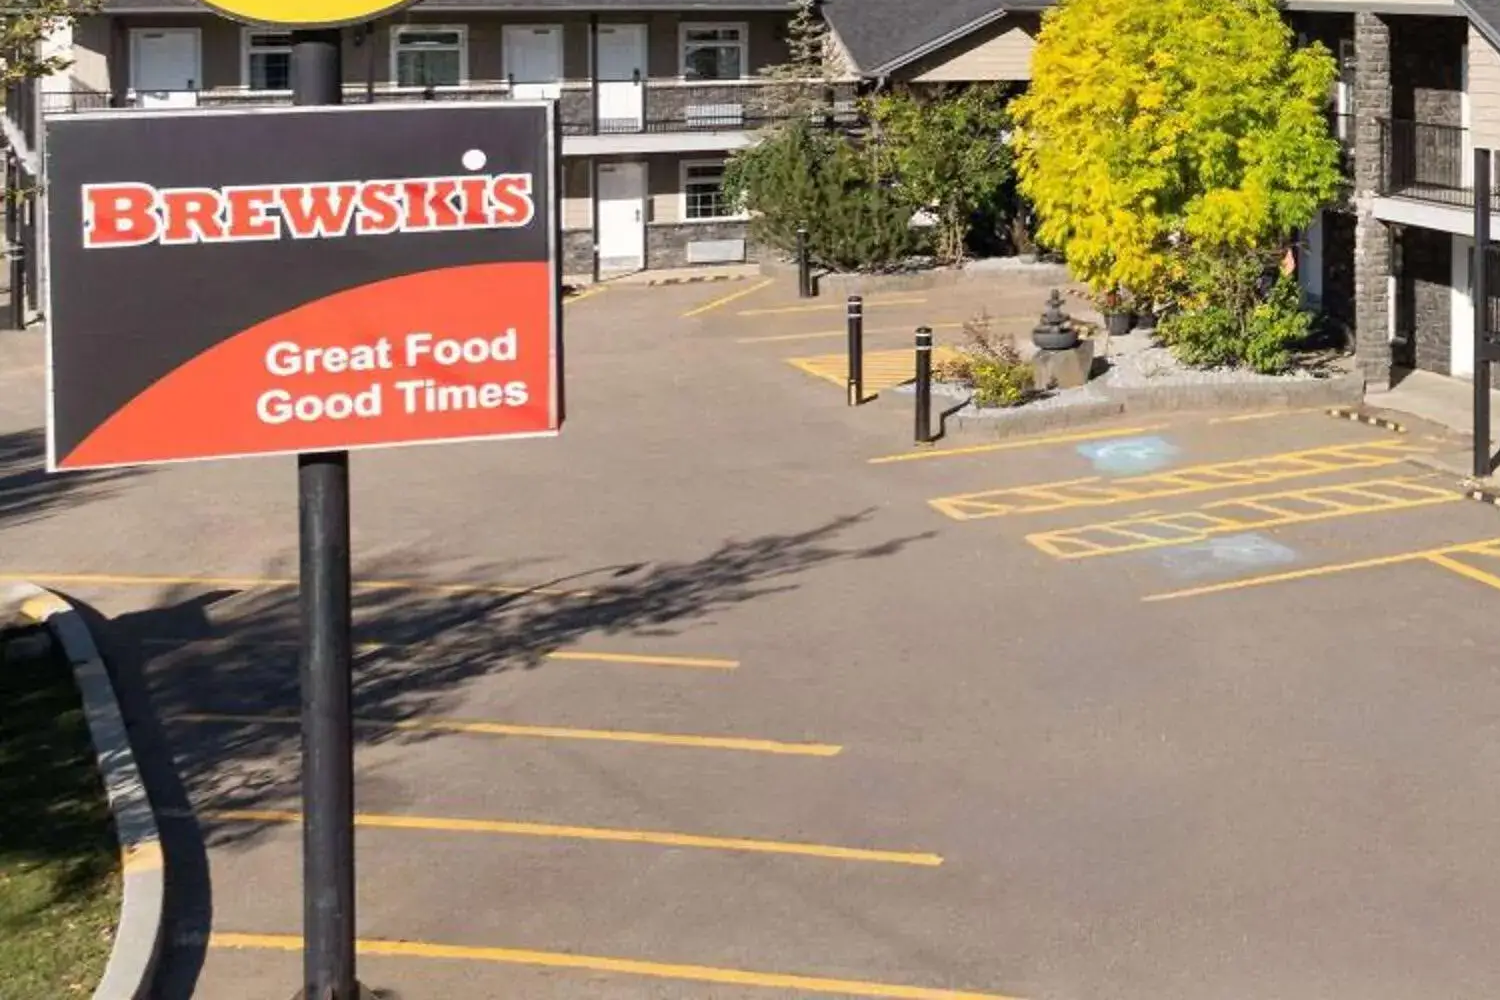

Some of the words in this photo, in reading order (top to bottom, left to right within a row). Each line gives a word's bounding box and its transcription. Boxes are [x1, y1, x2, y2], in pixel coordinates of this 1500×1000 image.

[265, 338, 392, 376] Great
[406, 329, 517, 366] Food
[257, 387, 381, 424] Good
[395, 378, 528, 412] Times
